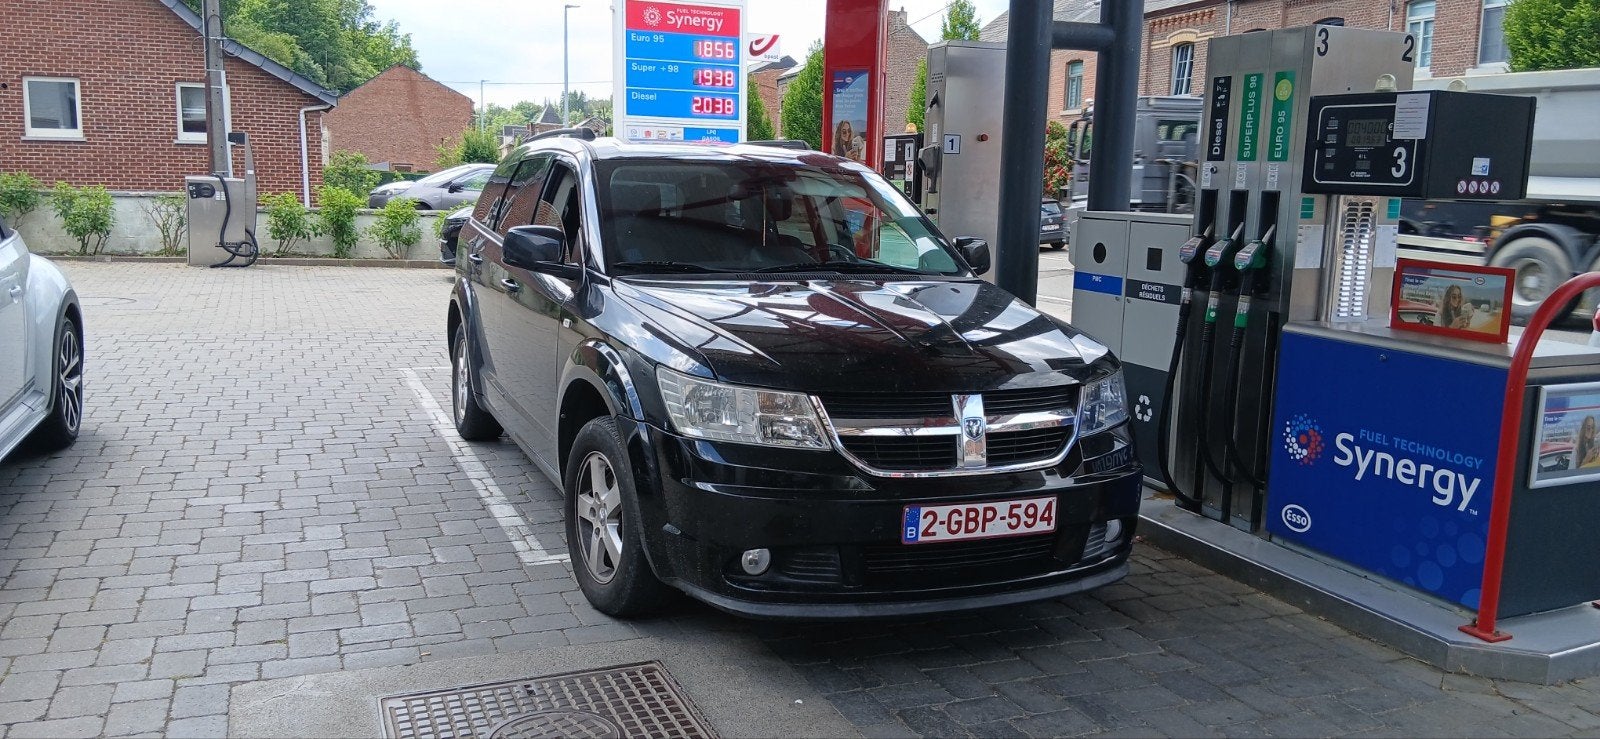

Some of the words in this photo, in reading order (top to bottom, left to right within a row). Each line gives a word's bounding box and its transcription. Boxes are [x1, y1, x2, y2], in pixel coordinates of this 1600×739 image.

[666, 10, 724, 32] Synergy
[690, 9, 724, 17] TECHNOLOGY
[631, 34, 650, 43] Euro
[653, 35, 665, 43] 95
[1316, 28, 1329, 57] 3
[1401, 34, 1415, 62] 2
[631, 63, 656, 74] Super
[631, 91, 657, 101] Diesel
[1243, 92, 1256, 158] SUPERPLUS
[1250, 75, 1258, 89] 98
[1278, 110, 1286, 124] 95
[949, 138, 955, 151] 1
[1212, 118, 1223, 155] Diesel
[1274, 126, 1284, 158] EURO
[907, 146, 911, 158] 1
[1391, 146, 1407, 178] 3
[1138, 291, 1166, 301] RÉSIDUELS
[1141, 283, 1164, 293] DÉCHETS
[1359, 429, 1389, 446] FUEL
[1393, 437, 1484, 470] TECHNOLOGY
[1333, 432, 1481, 512] Synergy
[921, 500, 1053, 537] 2-GBP-594
[1286, 509, 1307, 527] Esso
[907, 526, 916, 539] B
